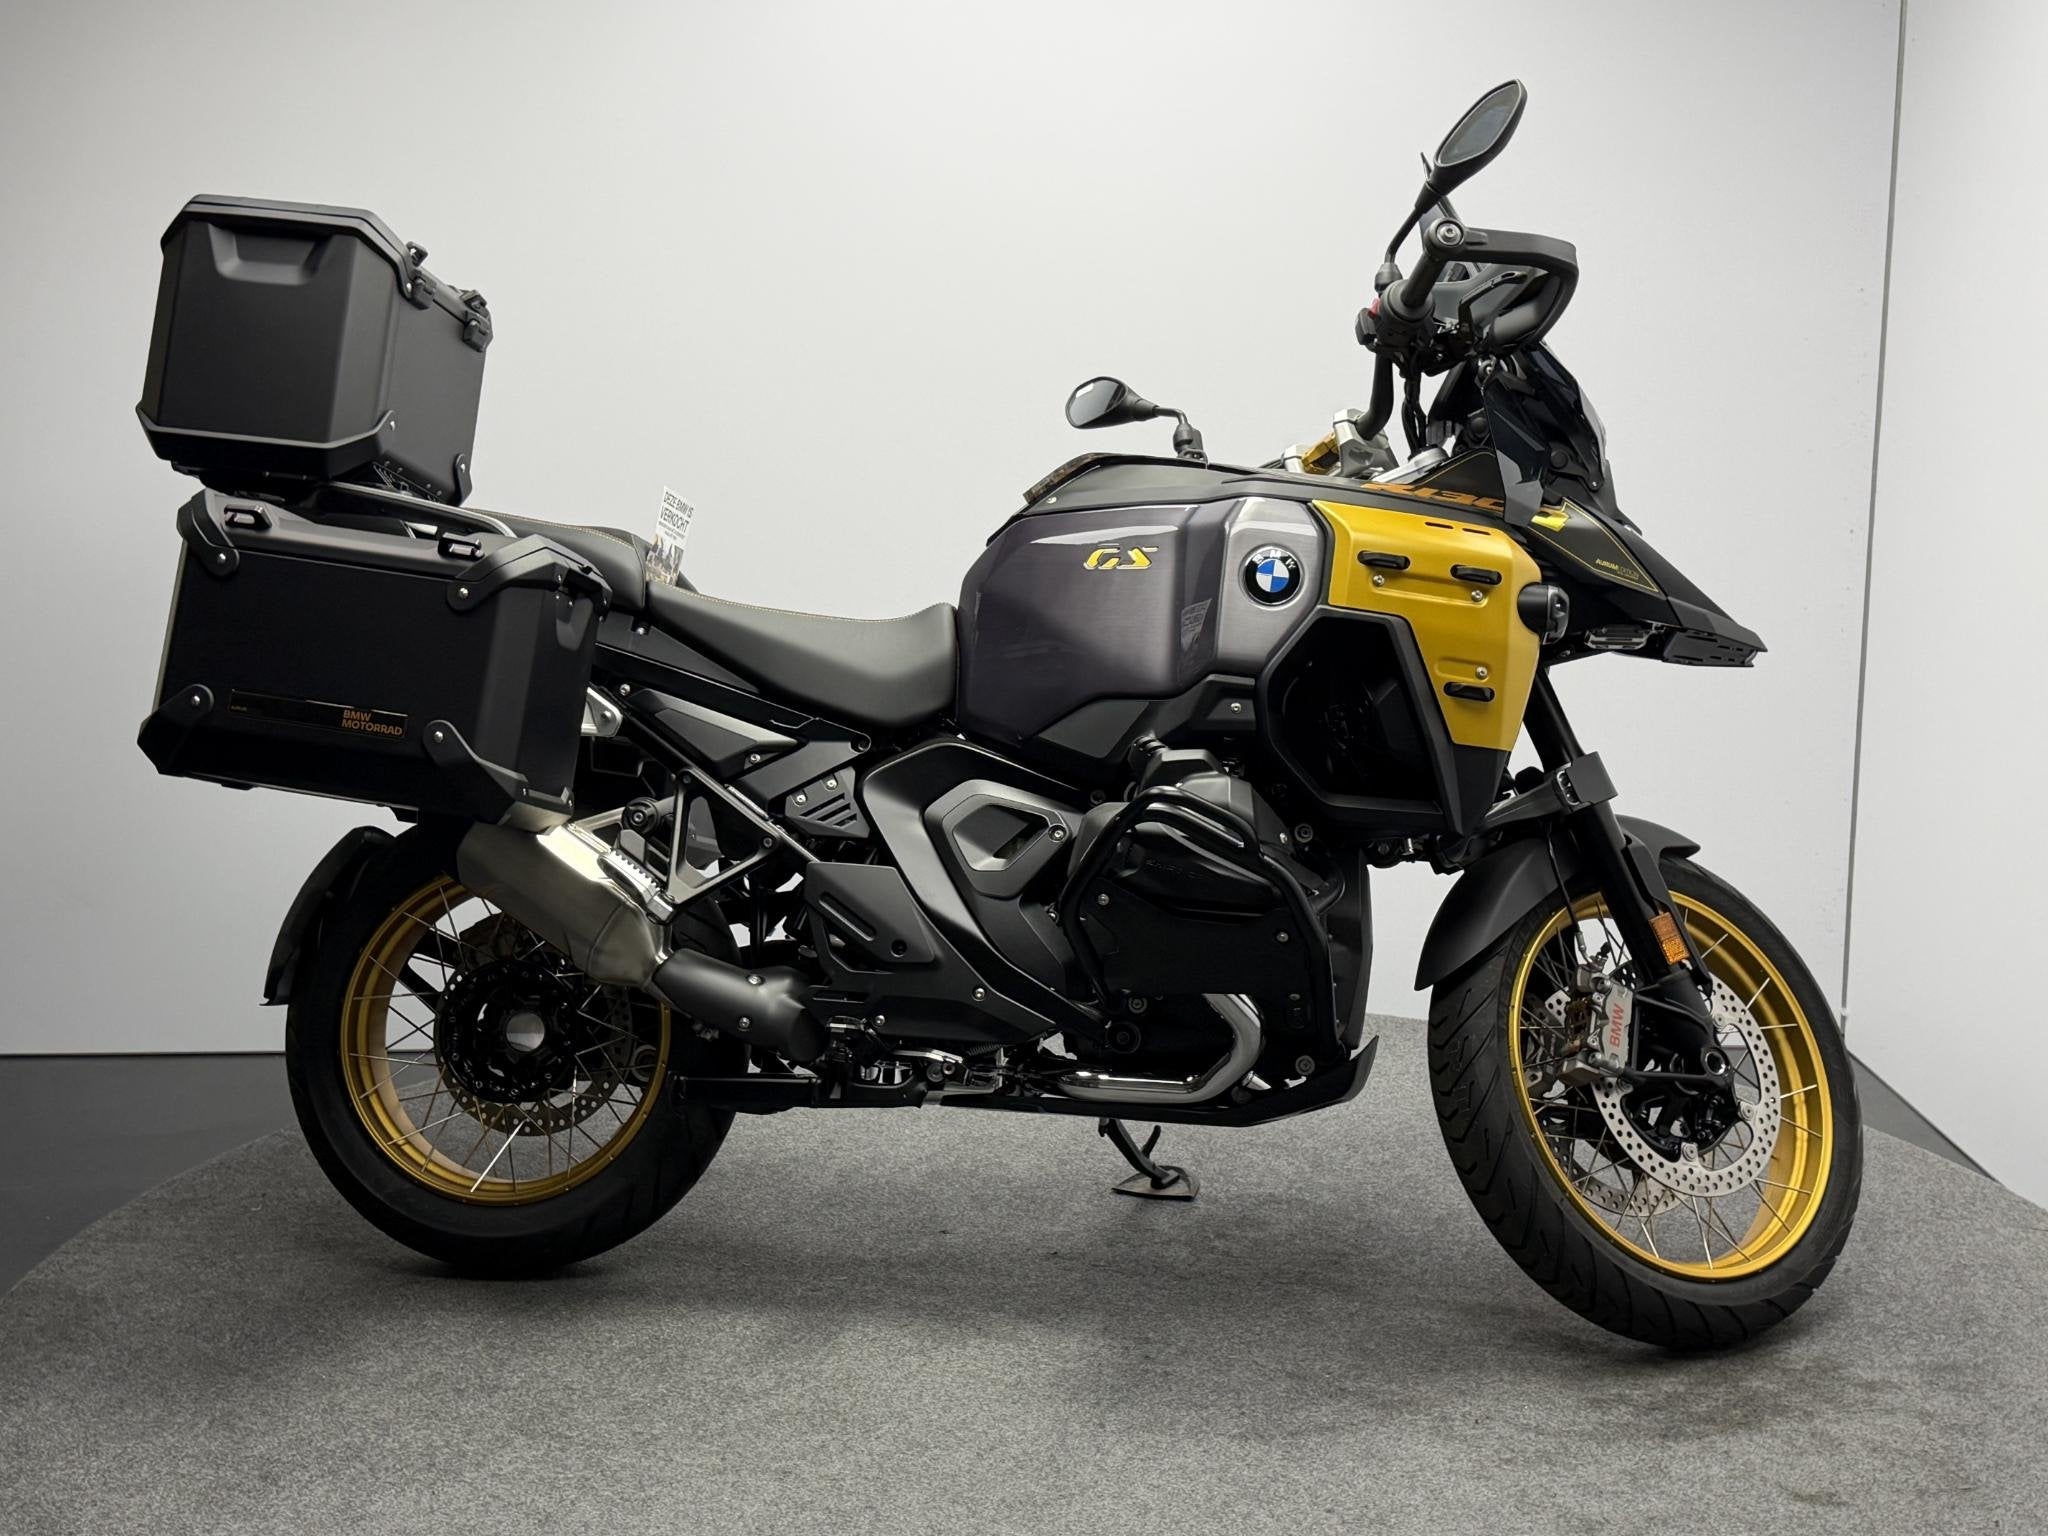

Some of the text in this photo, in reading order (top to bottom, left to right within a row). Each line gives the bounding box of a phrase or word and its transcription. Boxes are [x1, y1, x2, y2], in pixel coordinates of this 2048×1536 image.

[1083, 543, 1159, 570] GS
[1251, 550, 1297, 570] BMW
[343, 709, 372, 722] BMW
[341, 719, 403, 736] MOTORRAD
[1610, 1004, 1625, 1048] BMW
